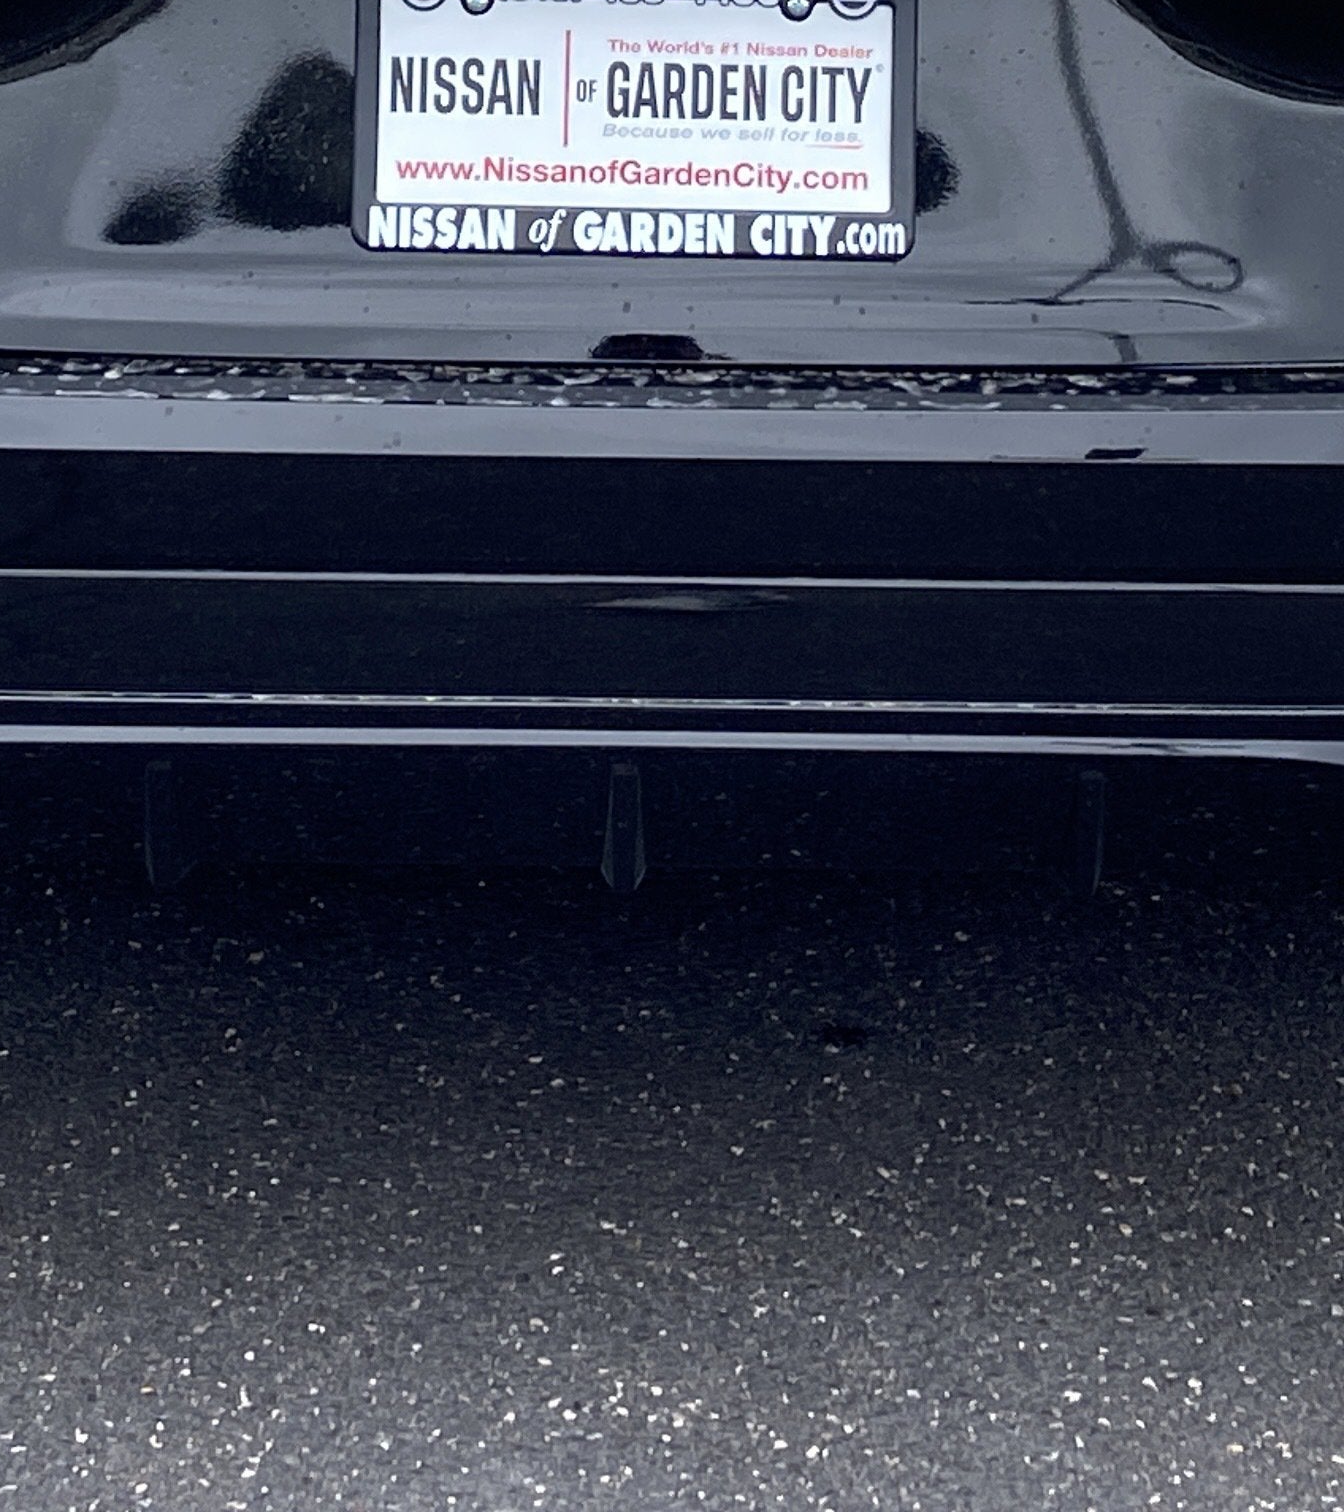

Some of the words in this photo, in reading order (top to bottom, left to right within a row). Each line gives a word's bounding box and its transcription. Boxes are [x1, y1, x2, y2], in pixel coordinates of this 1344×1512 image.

[608, 38, 641, 53] The
[647, 39, 714, 55] World's
[720, 41, 739, 55] #1
[747, 42, 806, 57] Nissan
[814, 44, 873, 59] Dealer
[390, 56, 541, 116] NISSAN
[576, 78, 598, 103] OF
[607, 61, 767, 121] GARDEN
[781, 65, 872, 124] CITY
[602, 123, 693, 139] Because
[700, 127, 730, 140] we
[738, 126, 774, 141] sell
[781, 126, 809, 142] for
[396, 156, 868, 194] www.NissanofGardenCity.com
[367, 205, 516, 250] NISSAN
[528, 208, 567, 253] of
[573, 210, 735, 255] GARDEN
[750, 213, 906, 256] CITY.com
